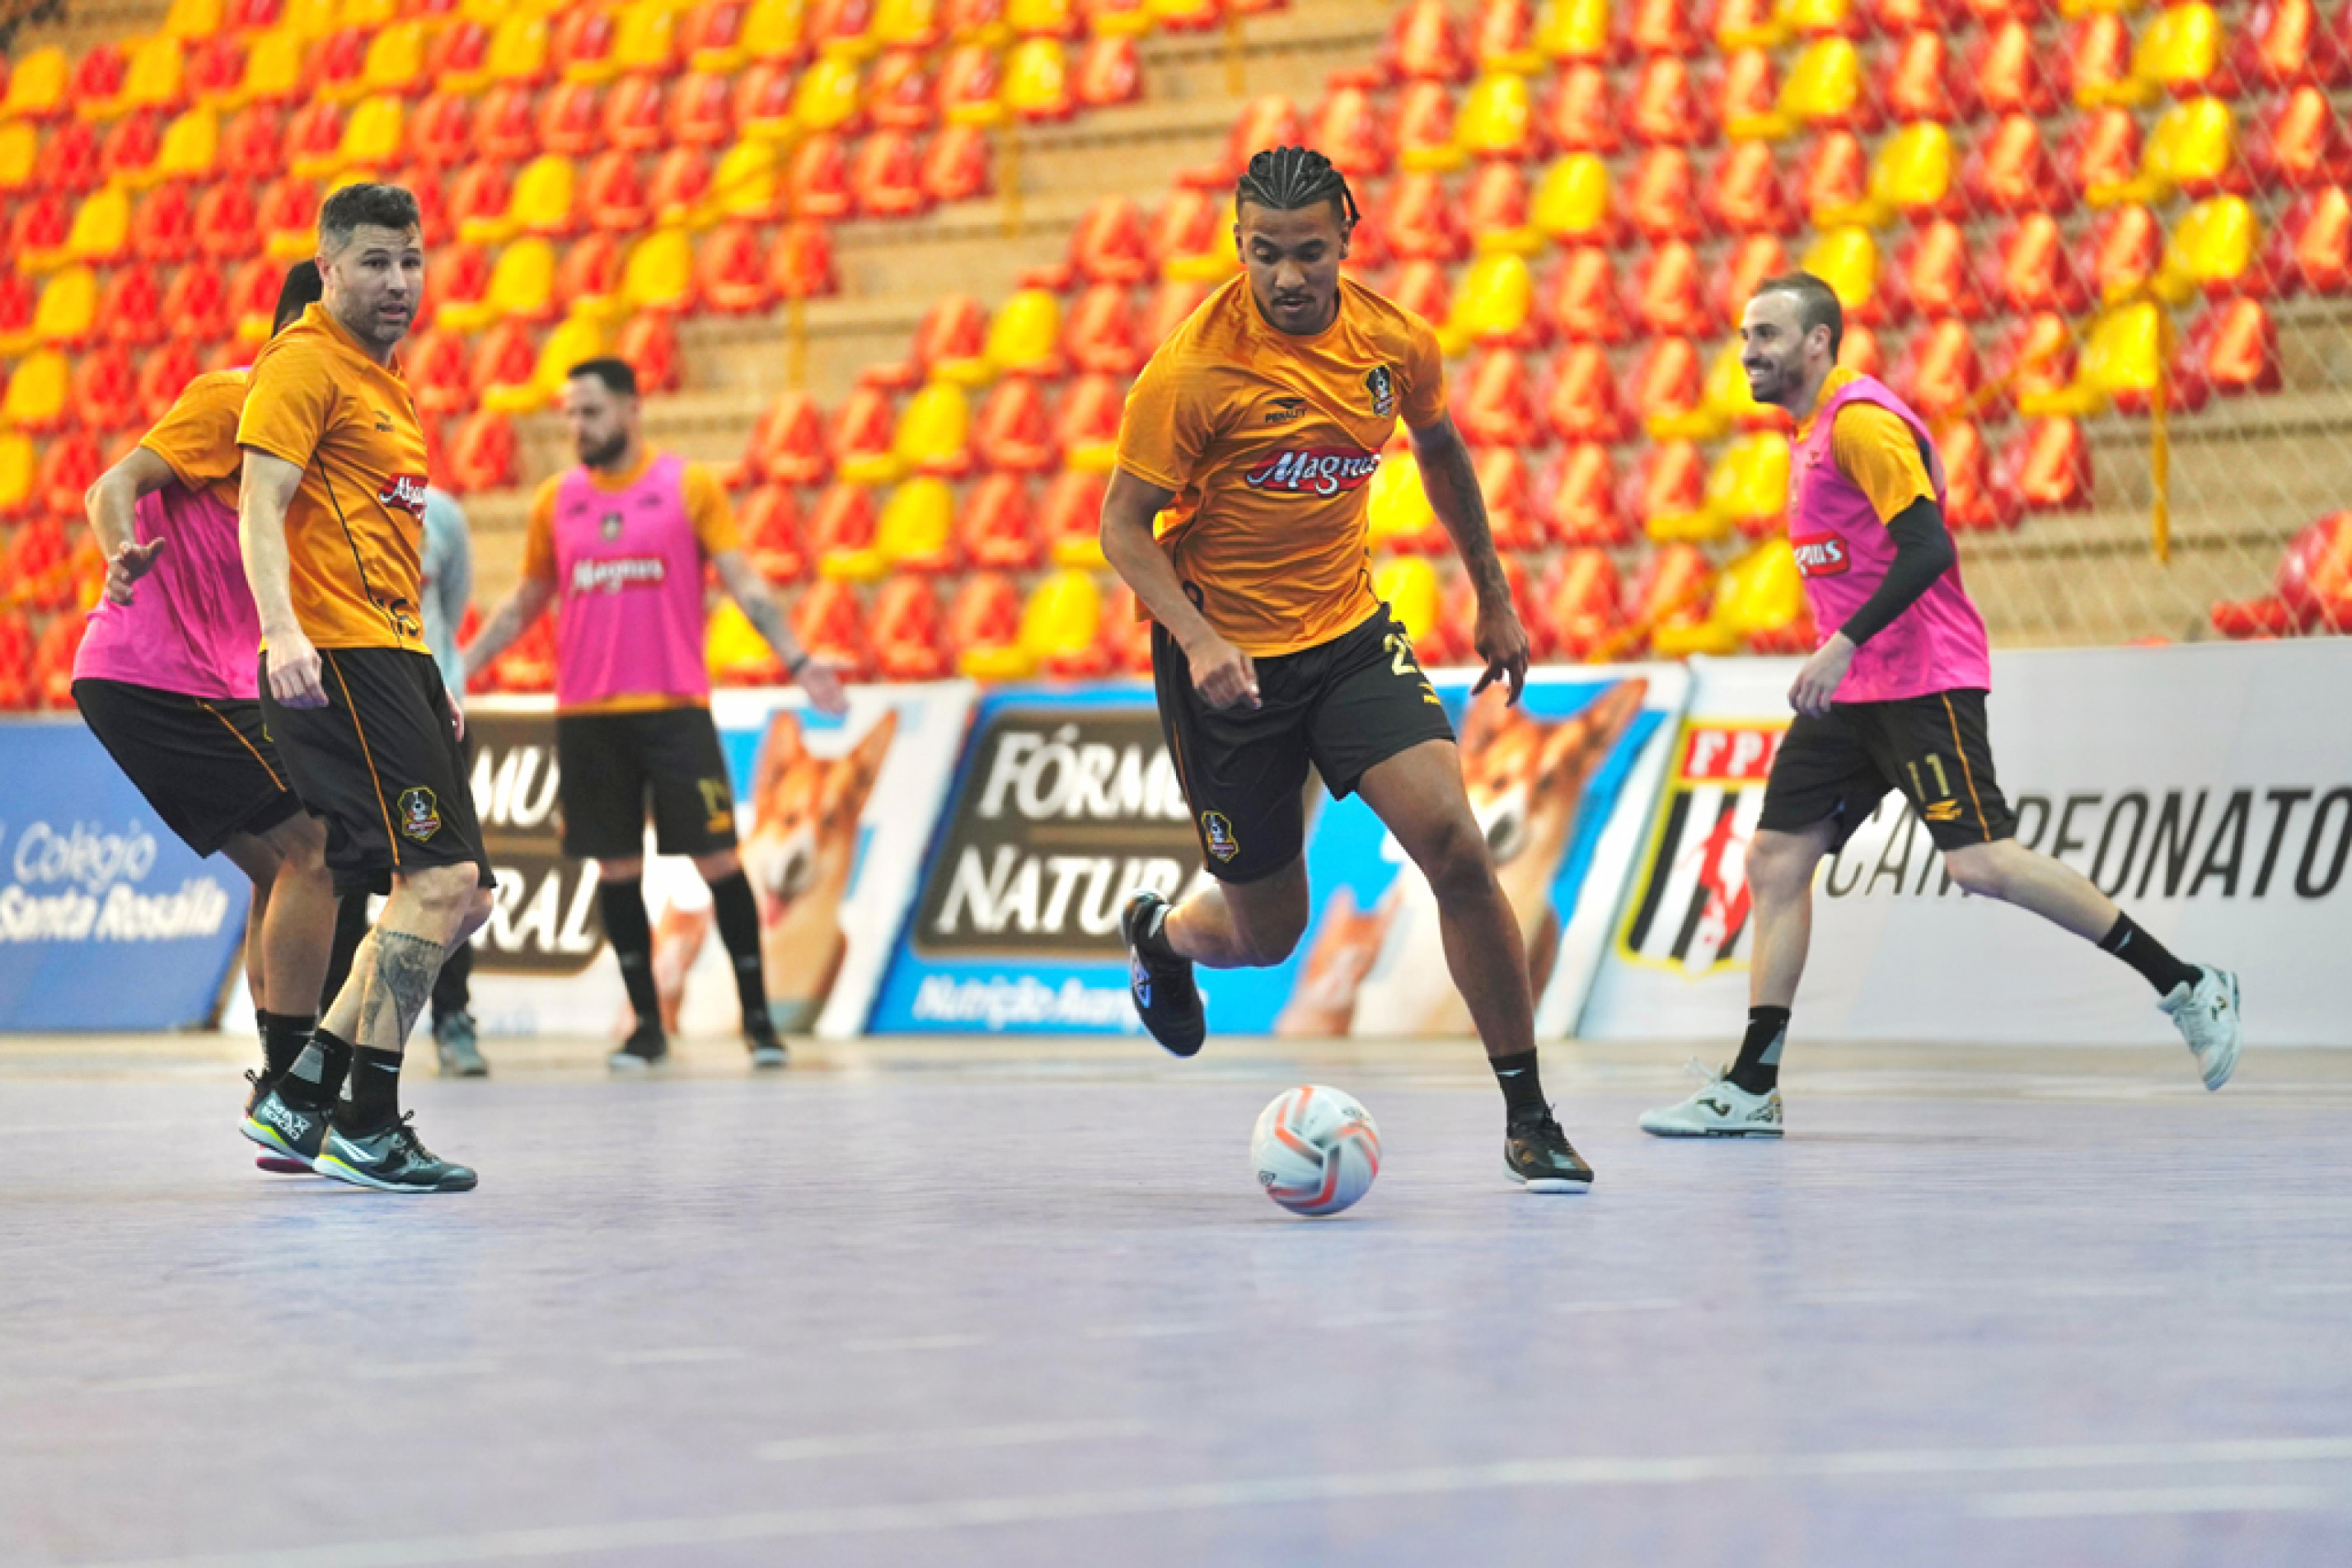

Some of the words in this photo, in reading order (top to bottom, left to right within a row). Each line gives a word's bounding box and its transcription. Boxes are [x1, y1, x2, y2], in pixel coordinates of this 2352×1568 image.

[1383, 632, 1417, 676] 2
[979, 725, 1192, 820] FÓRM
[1689, 730, 1787, 778] FP
[1905, 753, 1951, 803] 11
